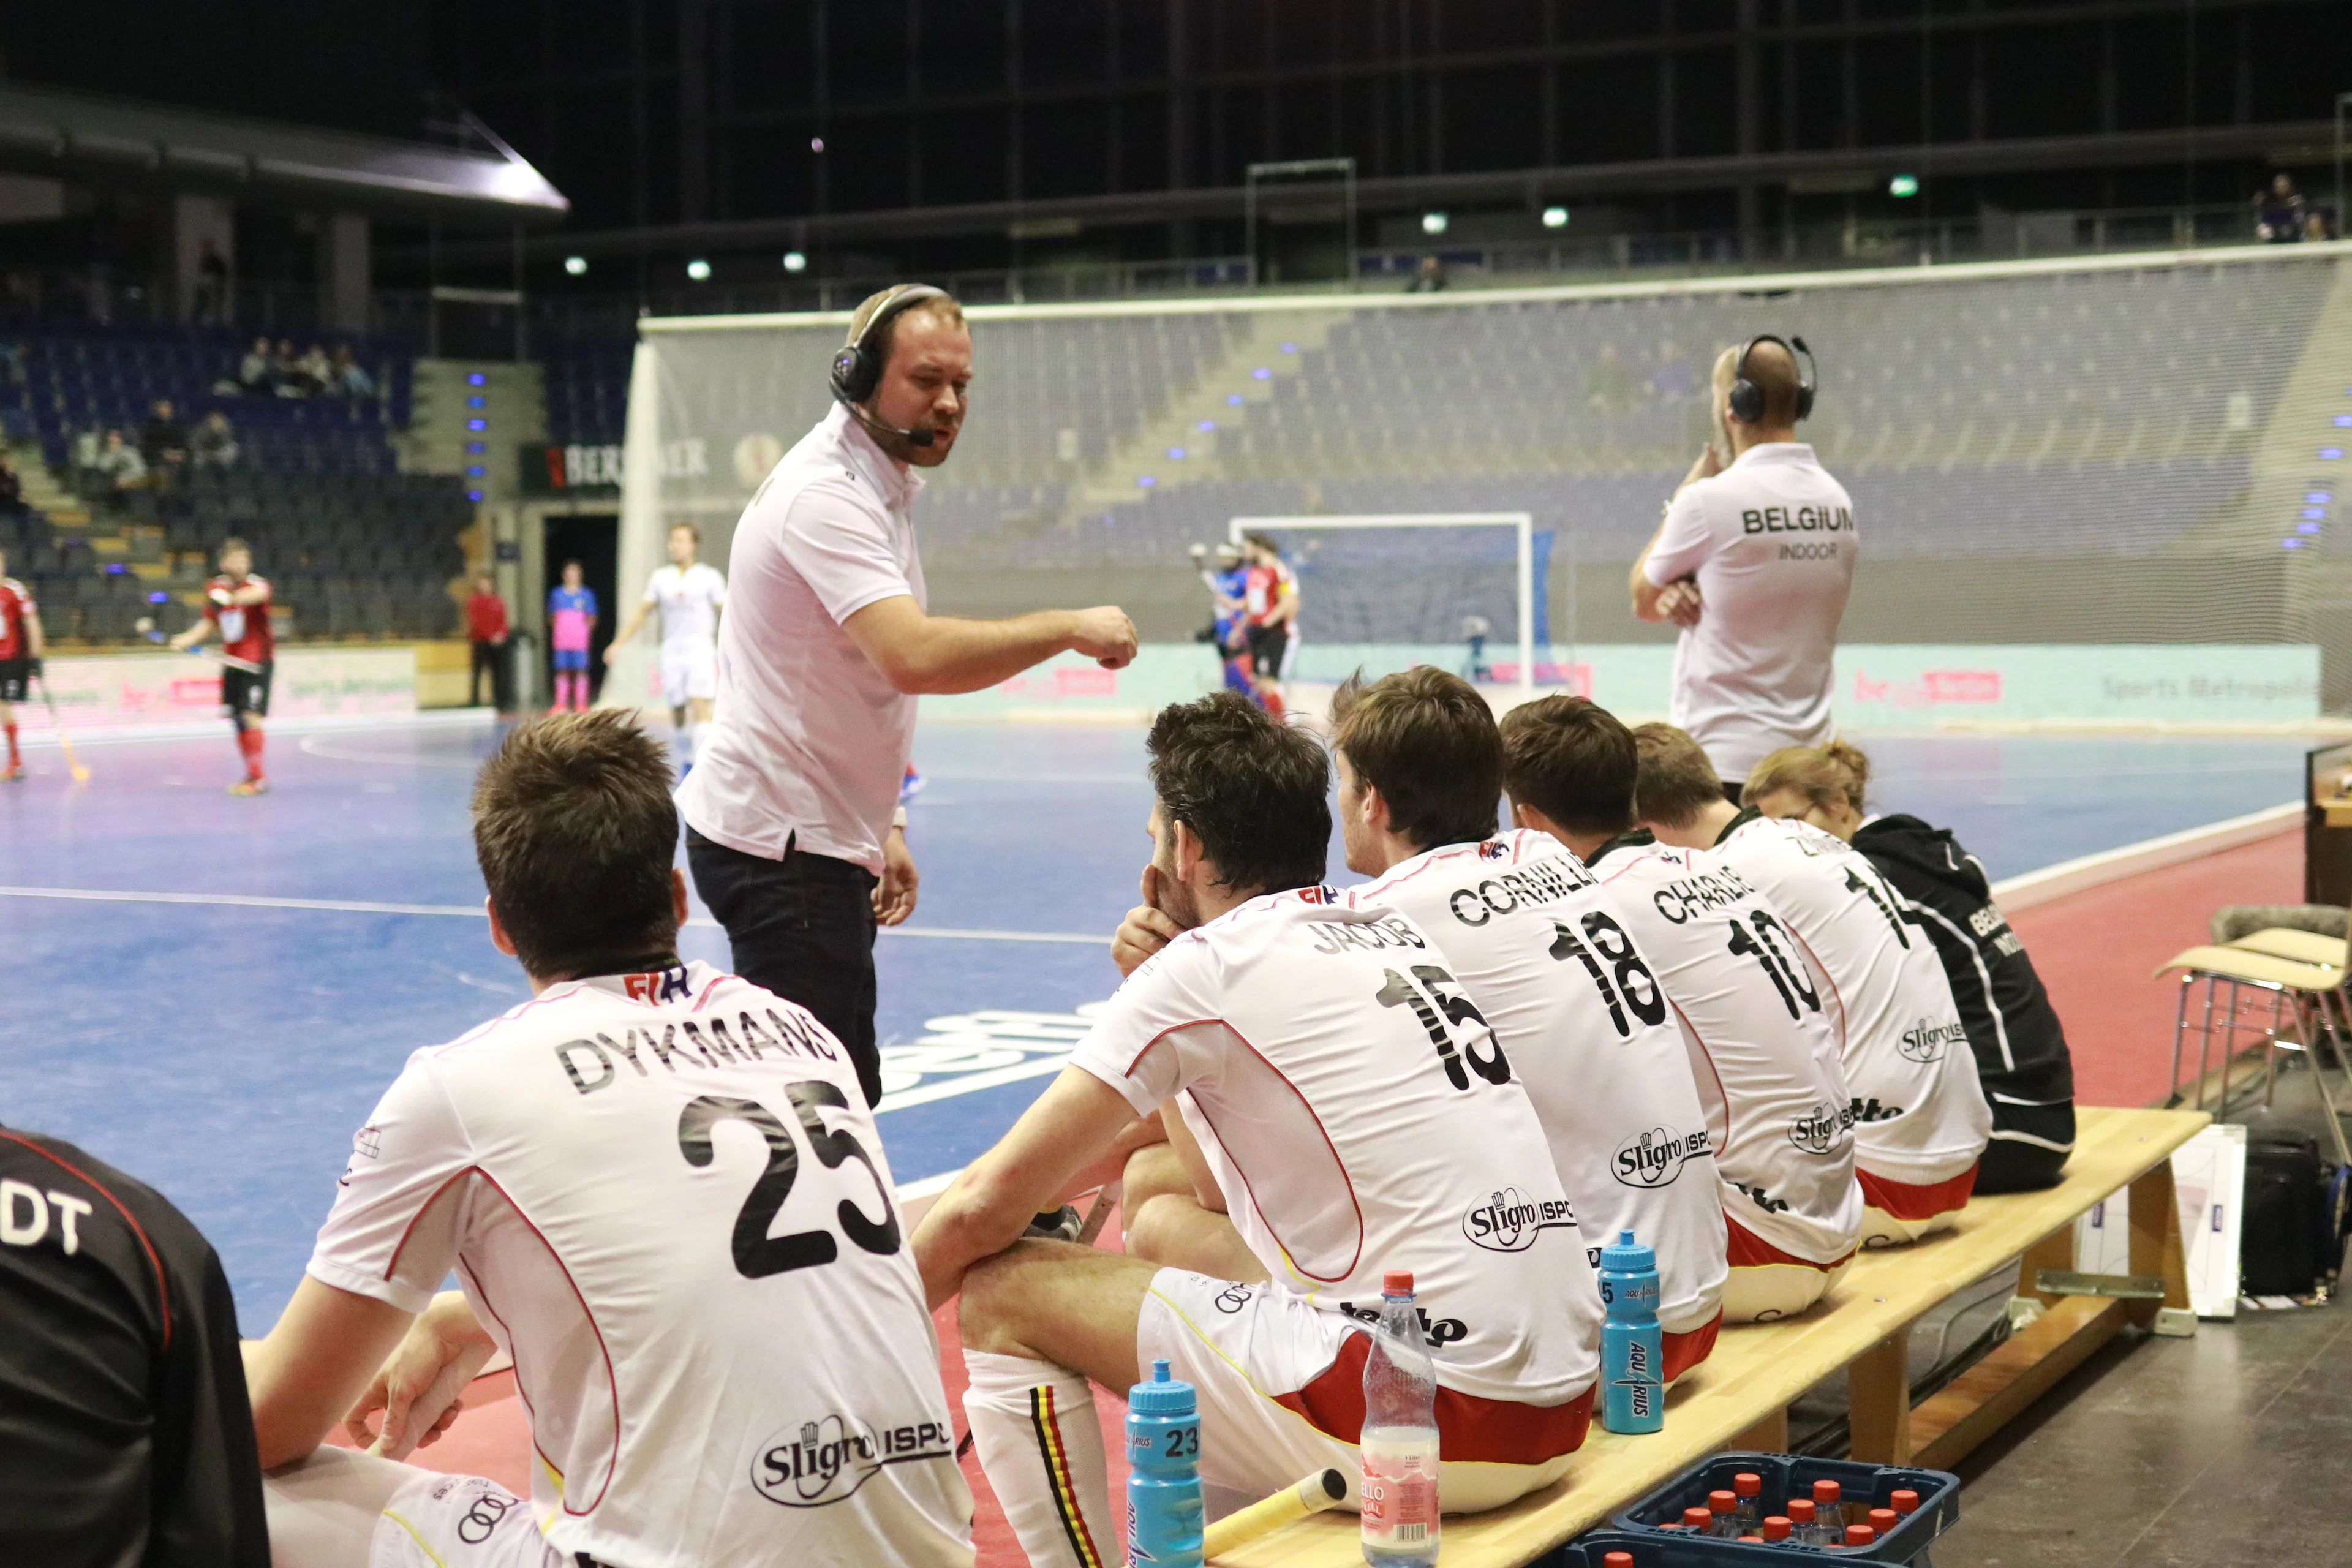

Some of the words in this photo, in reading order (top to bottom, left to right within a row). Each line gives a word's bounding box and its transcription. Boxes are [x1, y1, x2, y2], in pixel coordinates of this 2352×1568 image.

[1779, 543, 1838, 560] INDOOR
[1308, 918, 1425, 955] JACOB
[623, 967, 693, 1006] FIH
[1549, 911, 1666, 1037] 18
[1728, 910, 1821, 1020] 10
[554, 1008, 837, 1095] DYKMANS
[1376, 965, 1511, 1091] 15
[1902, 1026, 1948, 1053] Sligro
[678, 1080, 902, 1279] 25
[1618, 1137, 1683, 1177] Sligro
[0, 1178, 92, 1256] DT
[1470, 1203, 1536, 1239] Sligro
[1598, 1281, 1614, 1304] 5
[1611, 1340, 1661, 1417] AQUARIUS
[763, 1432, 875, 1488] Sligro
[1166, 1427, 1199, 1458] 23
